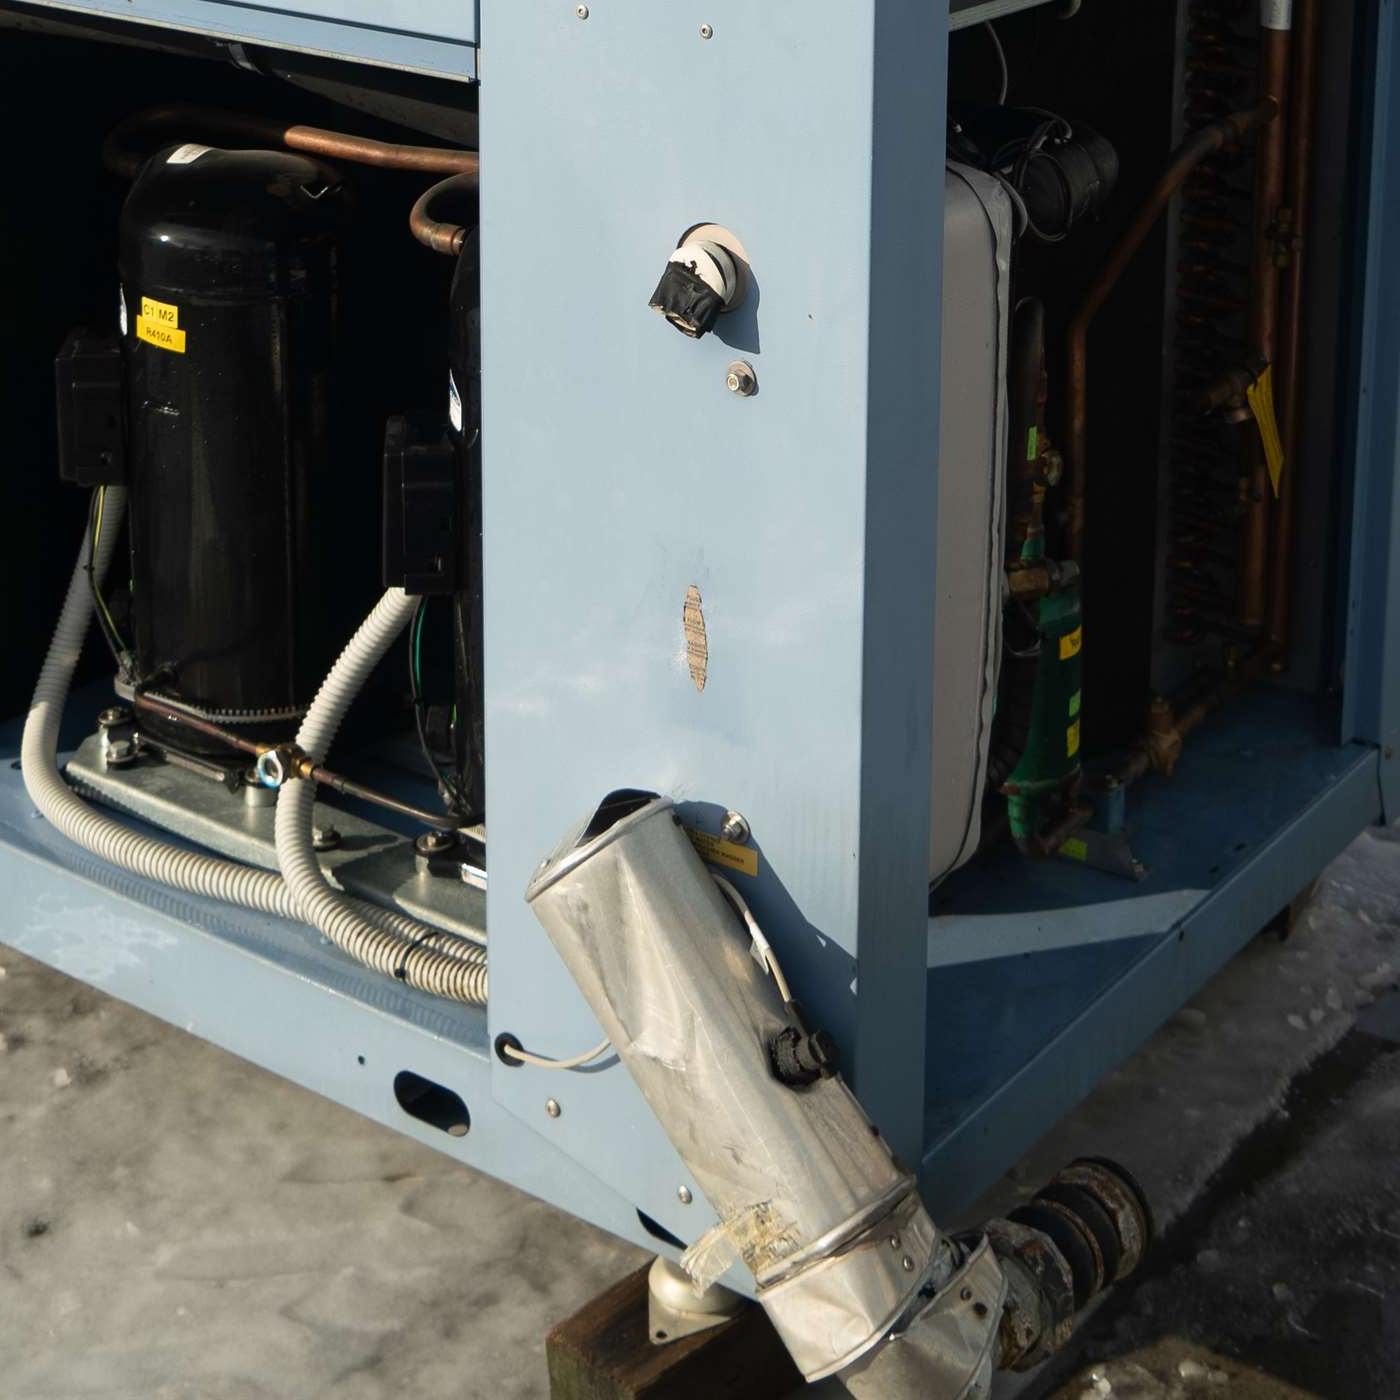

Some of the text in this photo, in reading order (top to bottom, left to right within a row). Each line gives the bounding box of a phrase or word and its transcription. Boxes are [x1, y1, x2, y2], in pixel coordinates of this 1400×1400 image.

[143, 304, 175, 322] C1 M2
[146, 326, 173, 344] R410A
